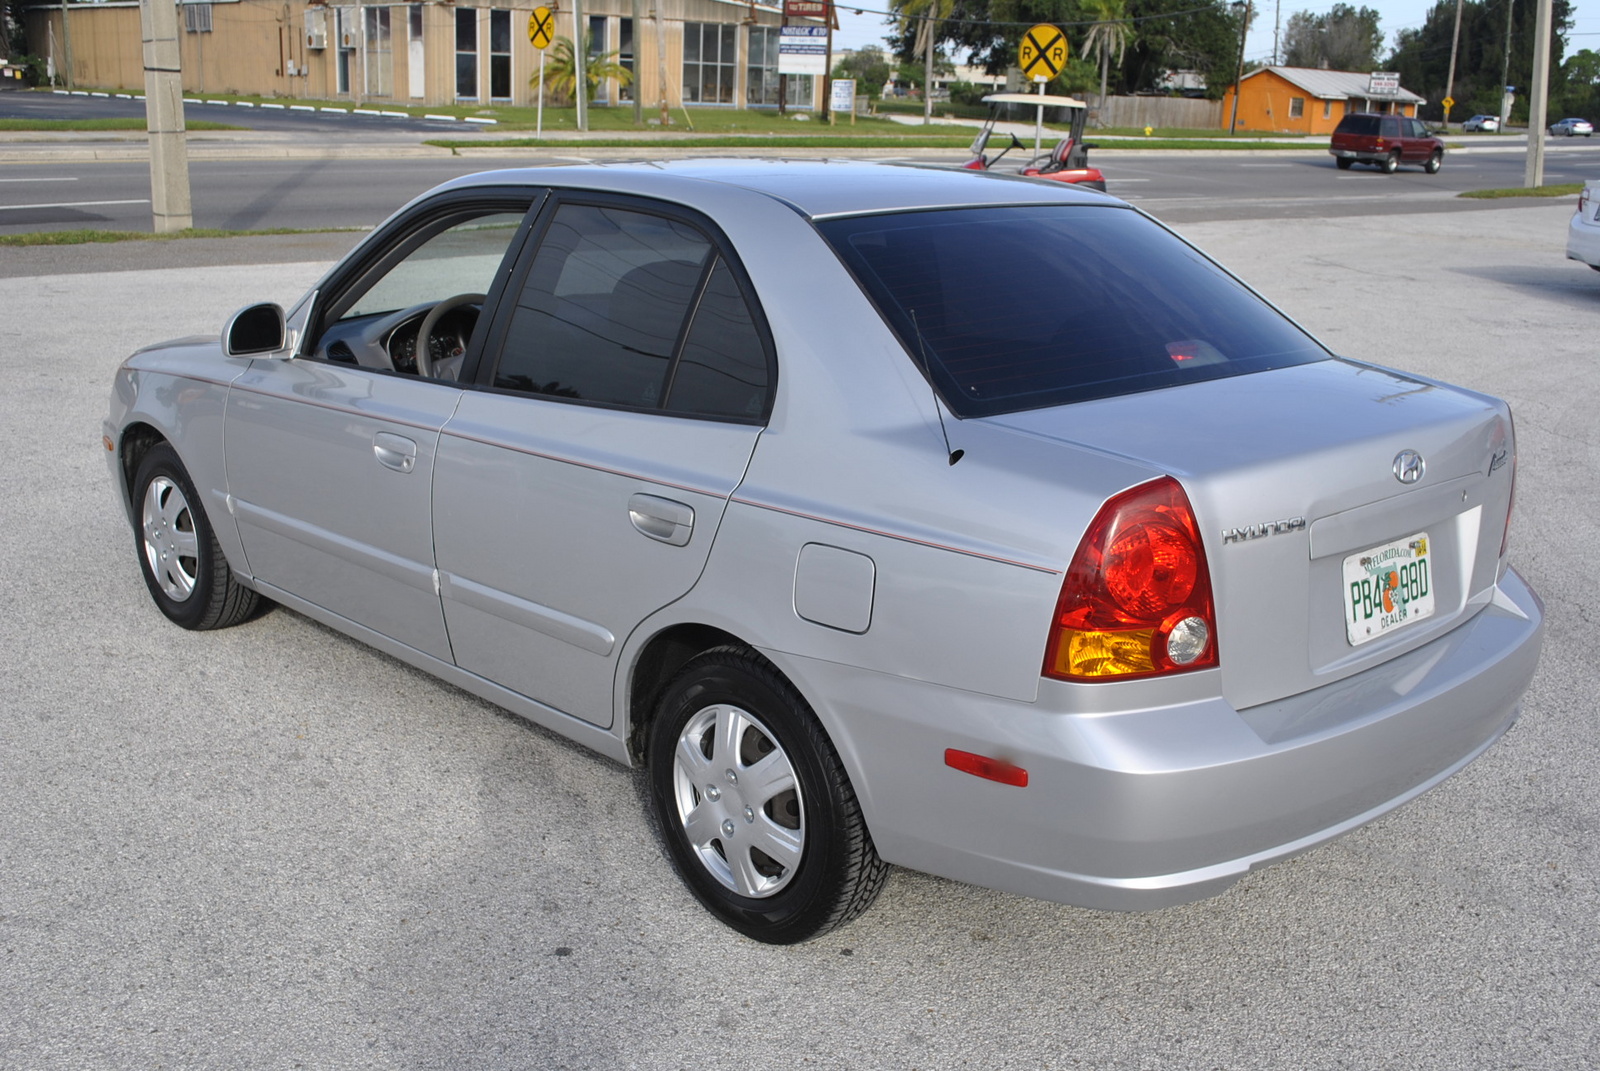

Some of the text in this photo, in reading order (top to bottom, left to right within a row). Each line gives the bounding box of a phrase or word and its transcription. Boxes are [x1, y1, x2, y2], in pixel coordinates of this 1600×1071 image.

[812, 27, 827, 35] AUTO
[1022, 46, 1063, 61] R R
[1221, 516, 1306, 545] HYUNDAI
[1350, 575, 1383, 623] PB4
[1380, 608, 1408, 629] DEALER
